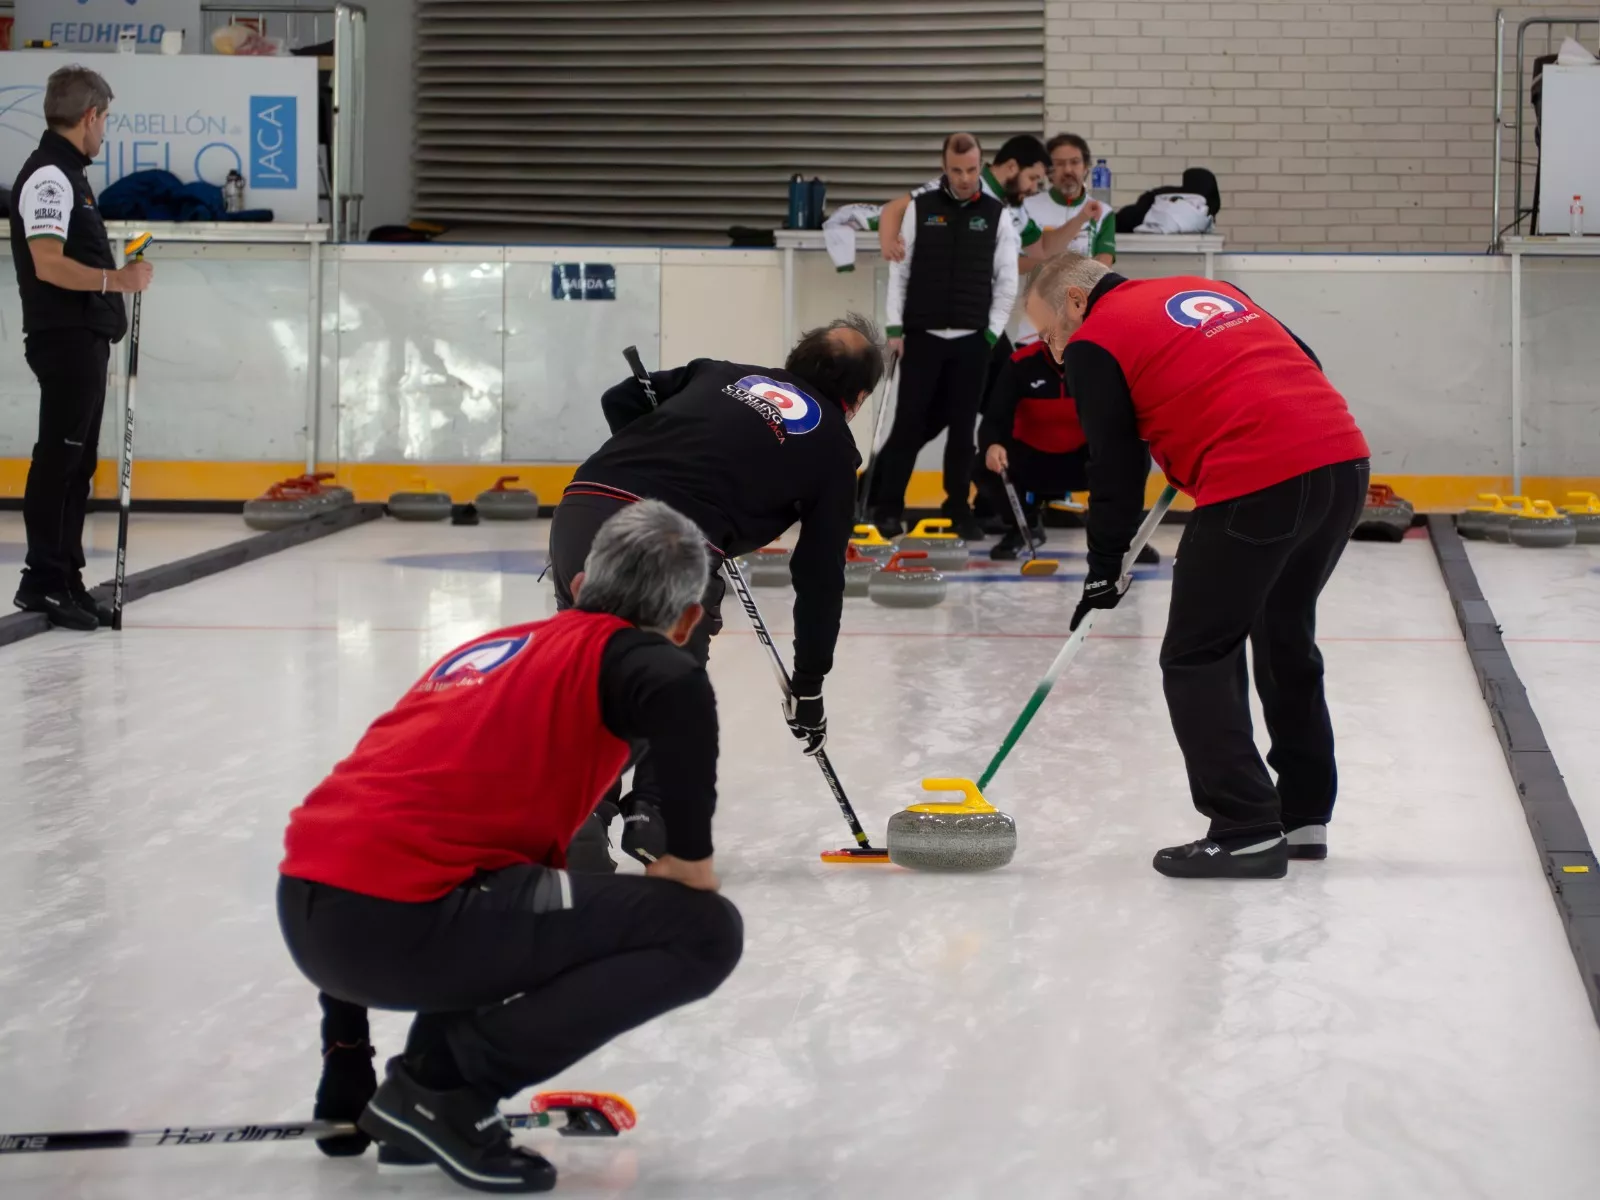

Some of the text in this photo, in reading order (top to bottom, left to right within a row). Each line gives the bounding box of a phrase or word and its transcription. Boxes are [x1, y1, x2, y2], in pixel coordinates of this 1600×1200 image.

[105, 109, 227, 135] PABELLÓN
[257, 104, 290, 183] JACA
[562, 278, 604, 290] ALDA
[726, 384, 784, 426] CURLING
[121, 408, 135, 489] Hardline
[722, 558, 772, 646] ardline
[0, 1134, 48, 1149] line
[157, 1125, 306, 1146] Hardline
